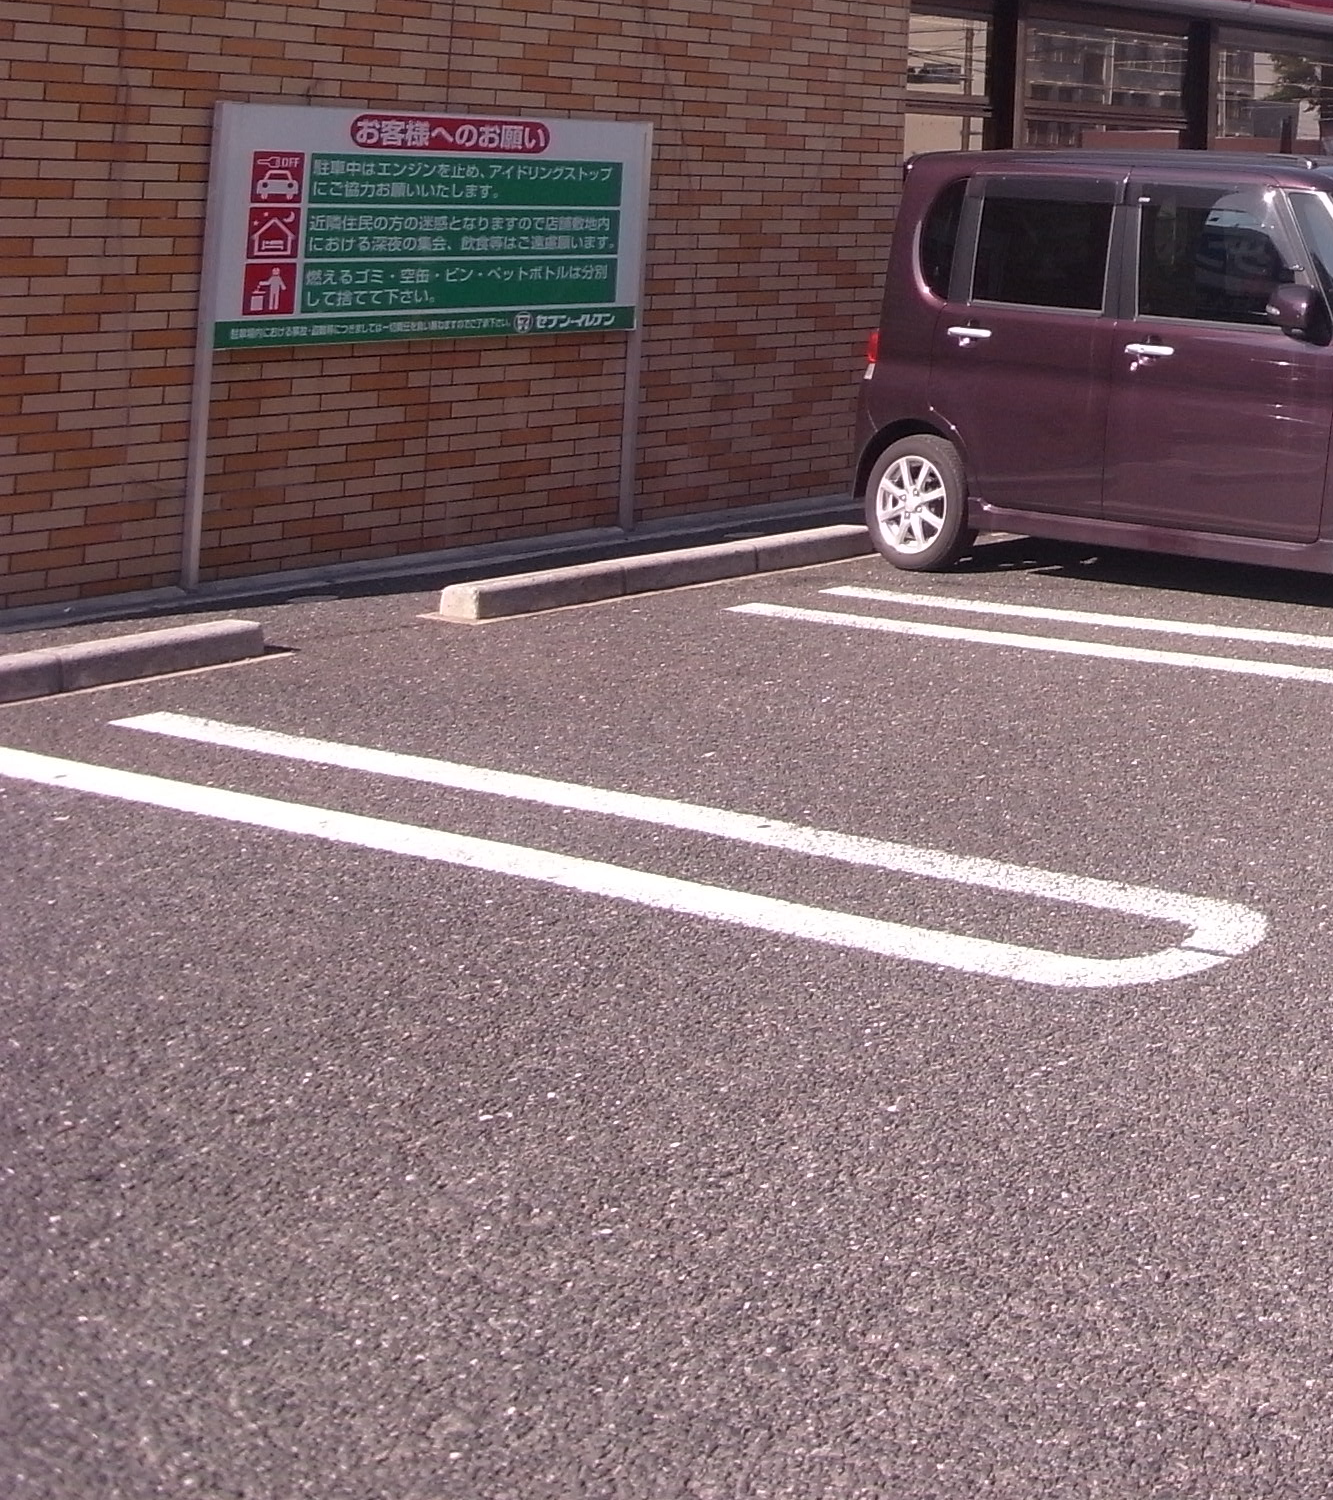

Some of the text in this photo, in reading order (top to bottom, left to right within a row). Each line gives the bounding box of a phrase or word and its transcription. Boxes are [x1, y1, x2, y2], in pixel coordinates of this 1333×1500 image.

[356, 119, 546, 148] お客様へのお願い
[281, 156, 300, 168] OFF
[313, 181, 498, 198] にご協力お願いいたします。
[307, 289, 435, 307] して捨てて下さい。
